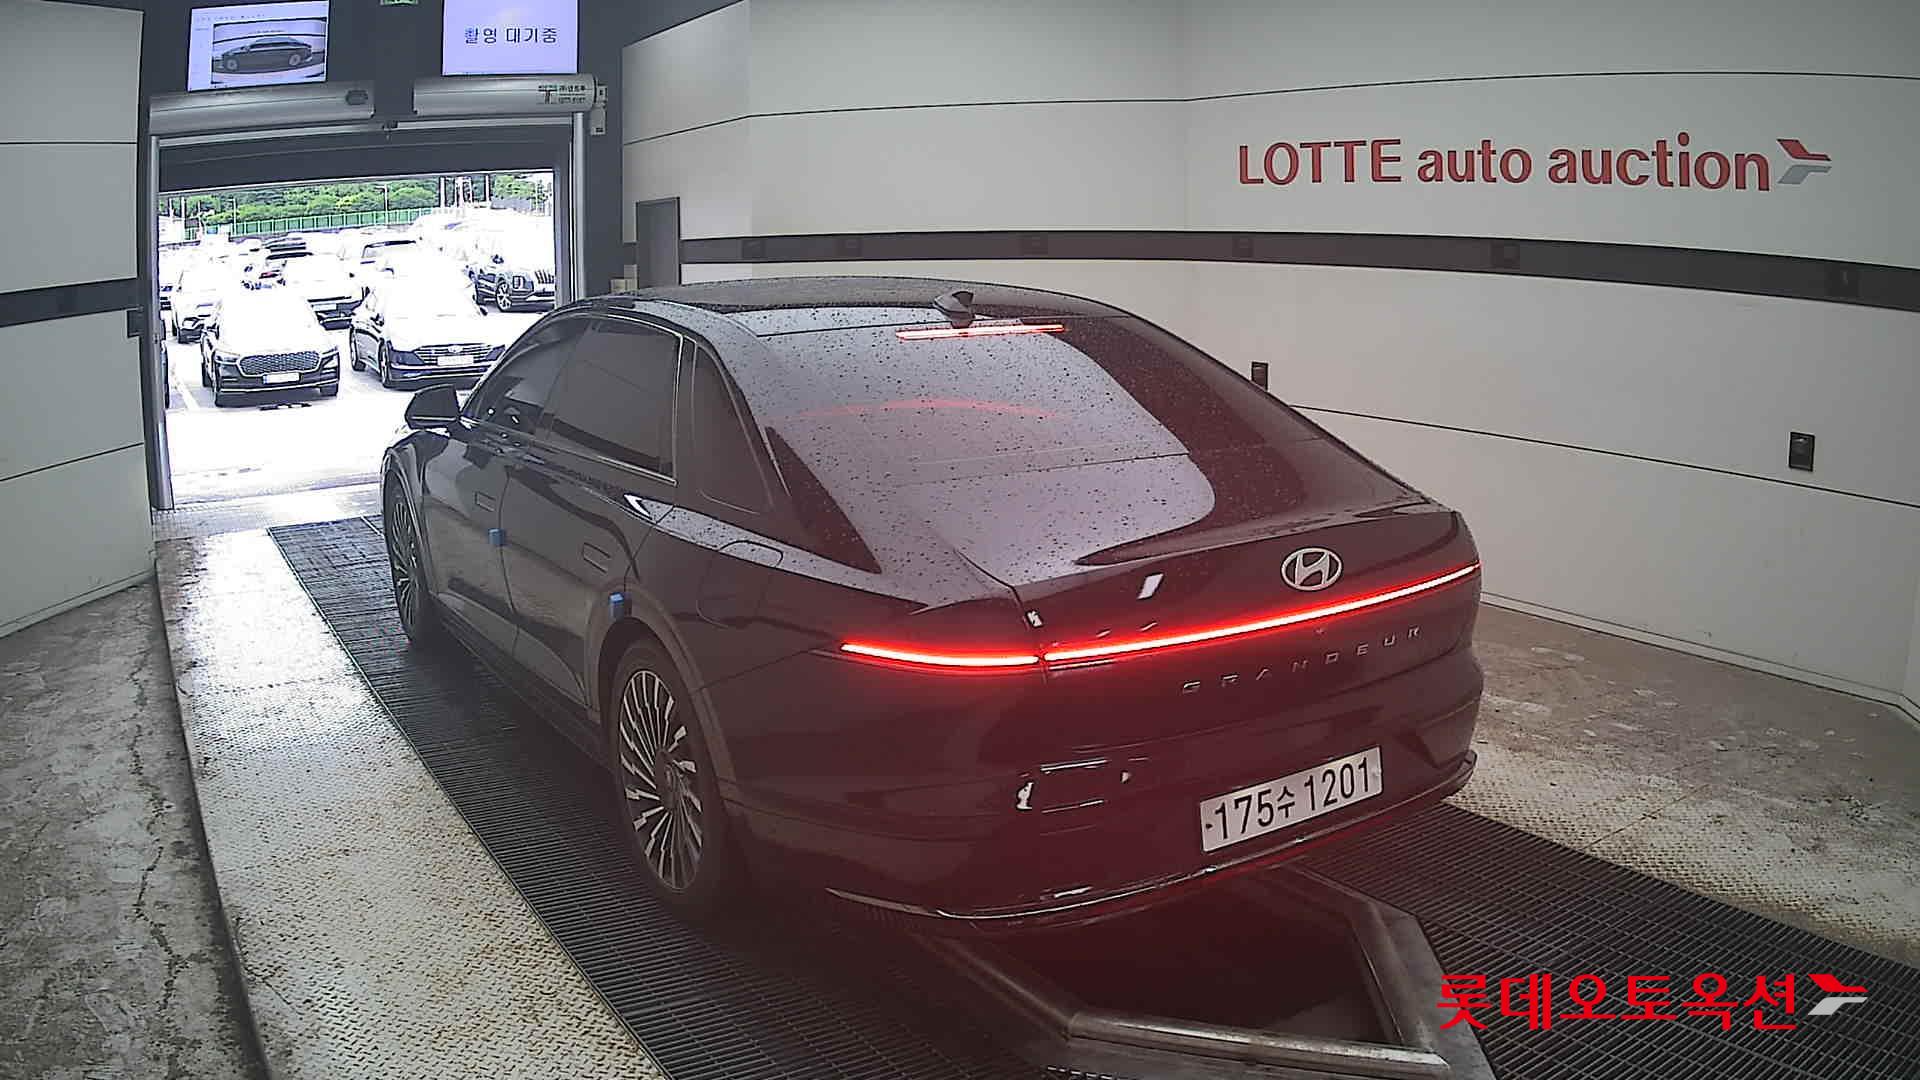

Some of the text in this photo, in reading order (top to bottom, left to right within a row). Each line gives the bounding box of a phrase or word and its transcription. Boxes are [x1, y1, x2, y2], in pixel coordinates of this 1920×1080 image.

[506, 27, 558, 44] 대기중
[1239, 132, 1771, 192] LOTTE auto auction
[1182, 625, 1420, 693] GRANDEUR
[1214, 757, 1369, 840] 175수 1201
